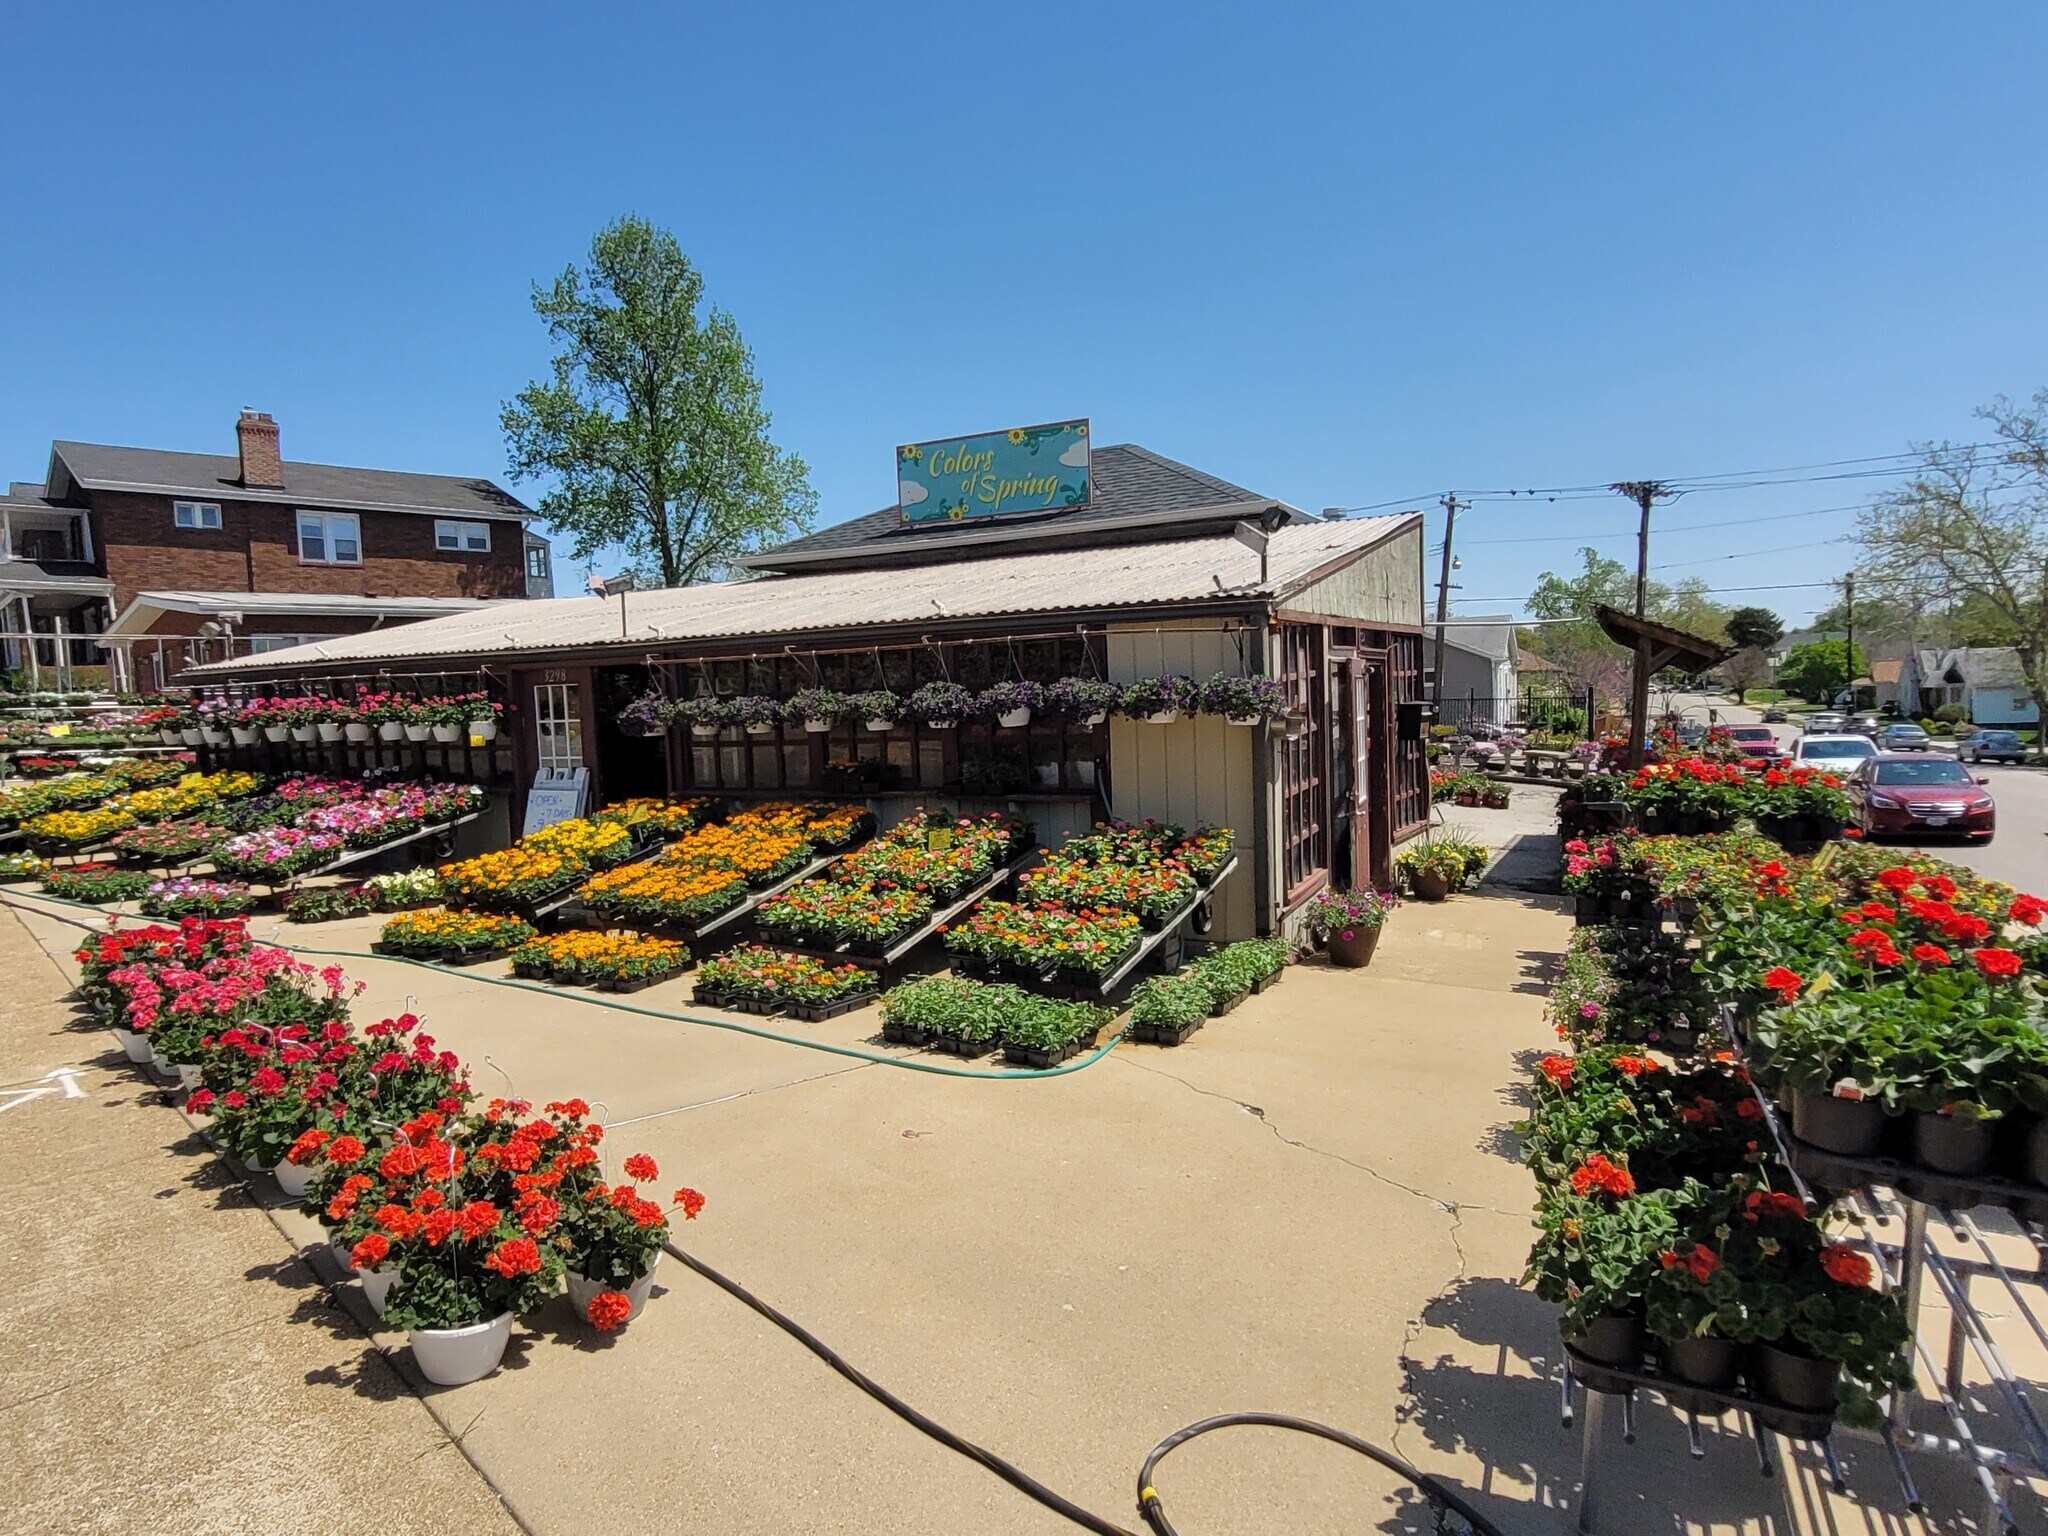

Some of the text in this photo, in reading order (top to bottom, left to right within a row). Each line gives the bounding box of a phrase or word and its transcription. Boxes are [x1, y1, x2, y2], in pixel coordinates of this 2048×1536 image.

[929, 444, 995, 478] Colors
[961, 471, 1058, 510] of Spring
[544, 669, 566, 682] 3298
[535, 794, 559, 806] OPEN
